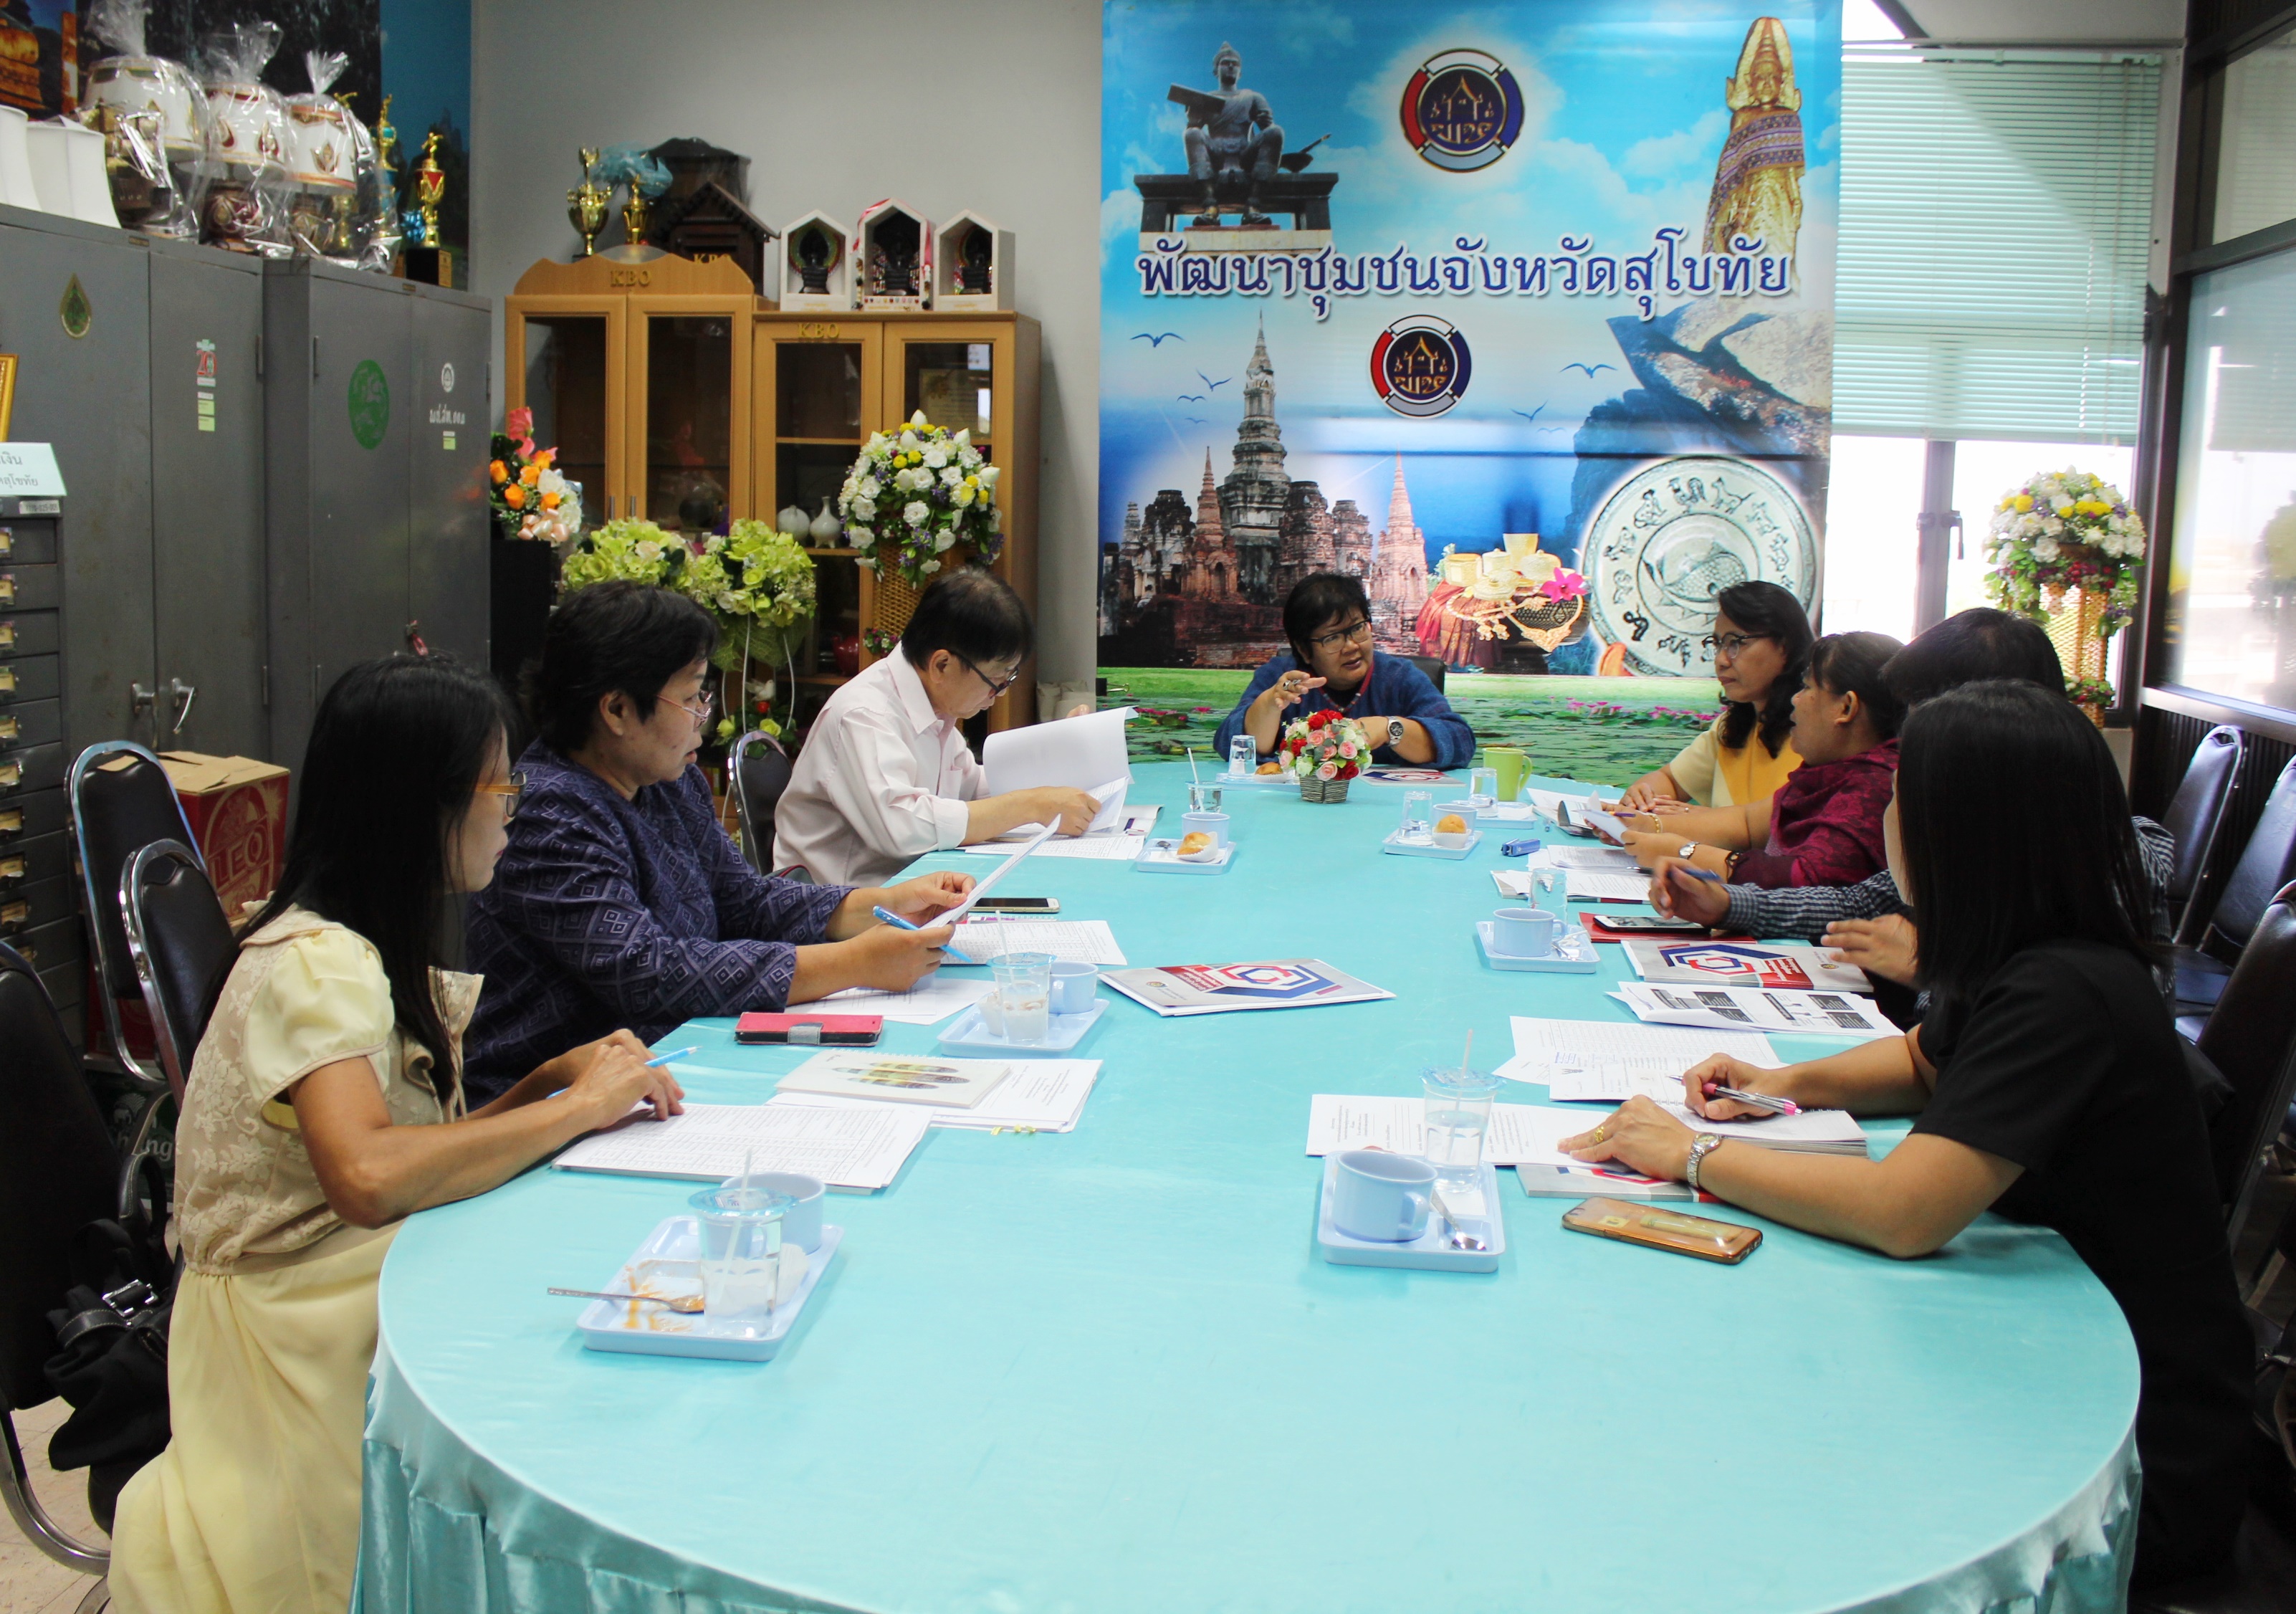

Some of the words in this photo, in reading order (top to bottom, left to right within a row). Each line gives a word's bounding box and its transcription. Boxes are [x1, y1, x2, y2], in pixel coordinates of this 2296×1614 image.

[611, 269, 652, 287] KBO
[1137, 227, 1788, 317] พัฒนาชุมชนจังหวัดสุโขทัย
[797, 323, 840, 340] KBO
[0, 451, 23, 465] เงิน
[208, 824, 269, 893] LEO
